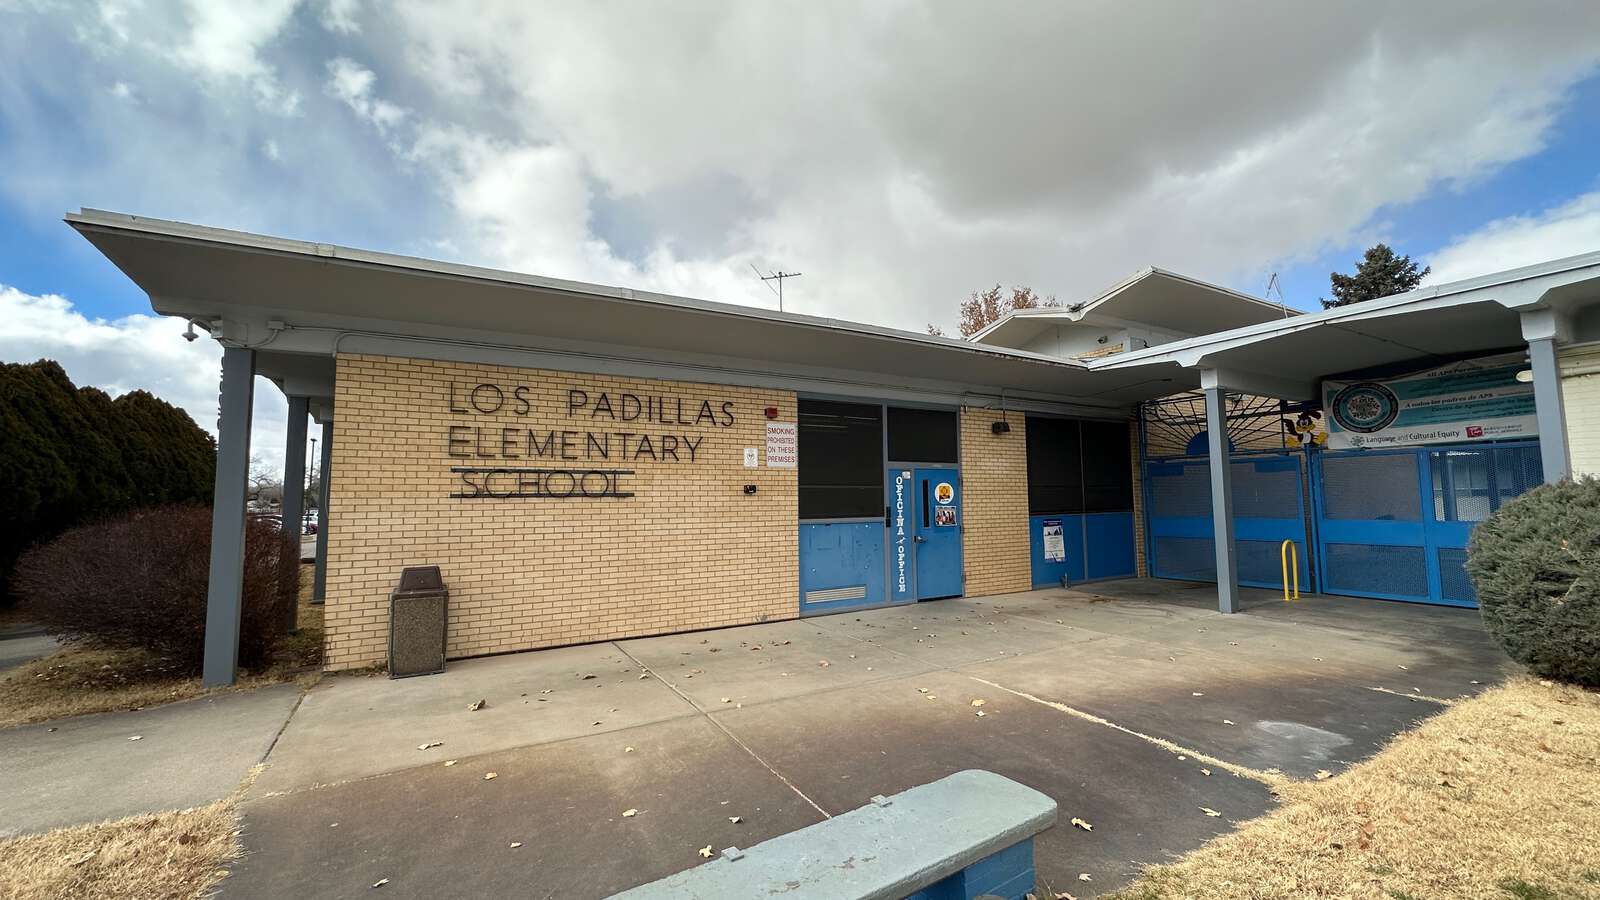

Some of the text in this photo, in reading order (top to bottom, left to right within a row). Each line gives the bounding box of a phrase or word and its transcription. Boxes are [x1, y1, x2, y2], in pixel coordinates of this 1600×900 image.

[449, 382, 735, 427] LOS PADILLAS
[448, 425, 704, 462] ELEMENTARY
[768, 427, 795, 435] SMOKING
[1366, 435, 1396, 444] Language
[1409, 430, 1436, 440] Cultural
[1437, 429, 1460, 440] Equity
[768, 446, 795, 454] ON THESE
[768, 455, 795, 463] PREMISES
[896, 476, 905, 535] OFICINA
[897, 545, 906, 592] OFFICE
